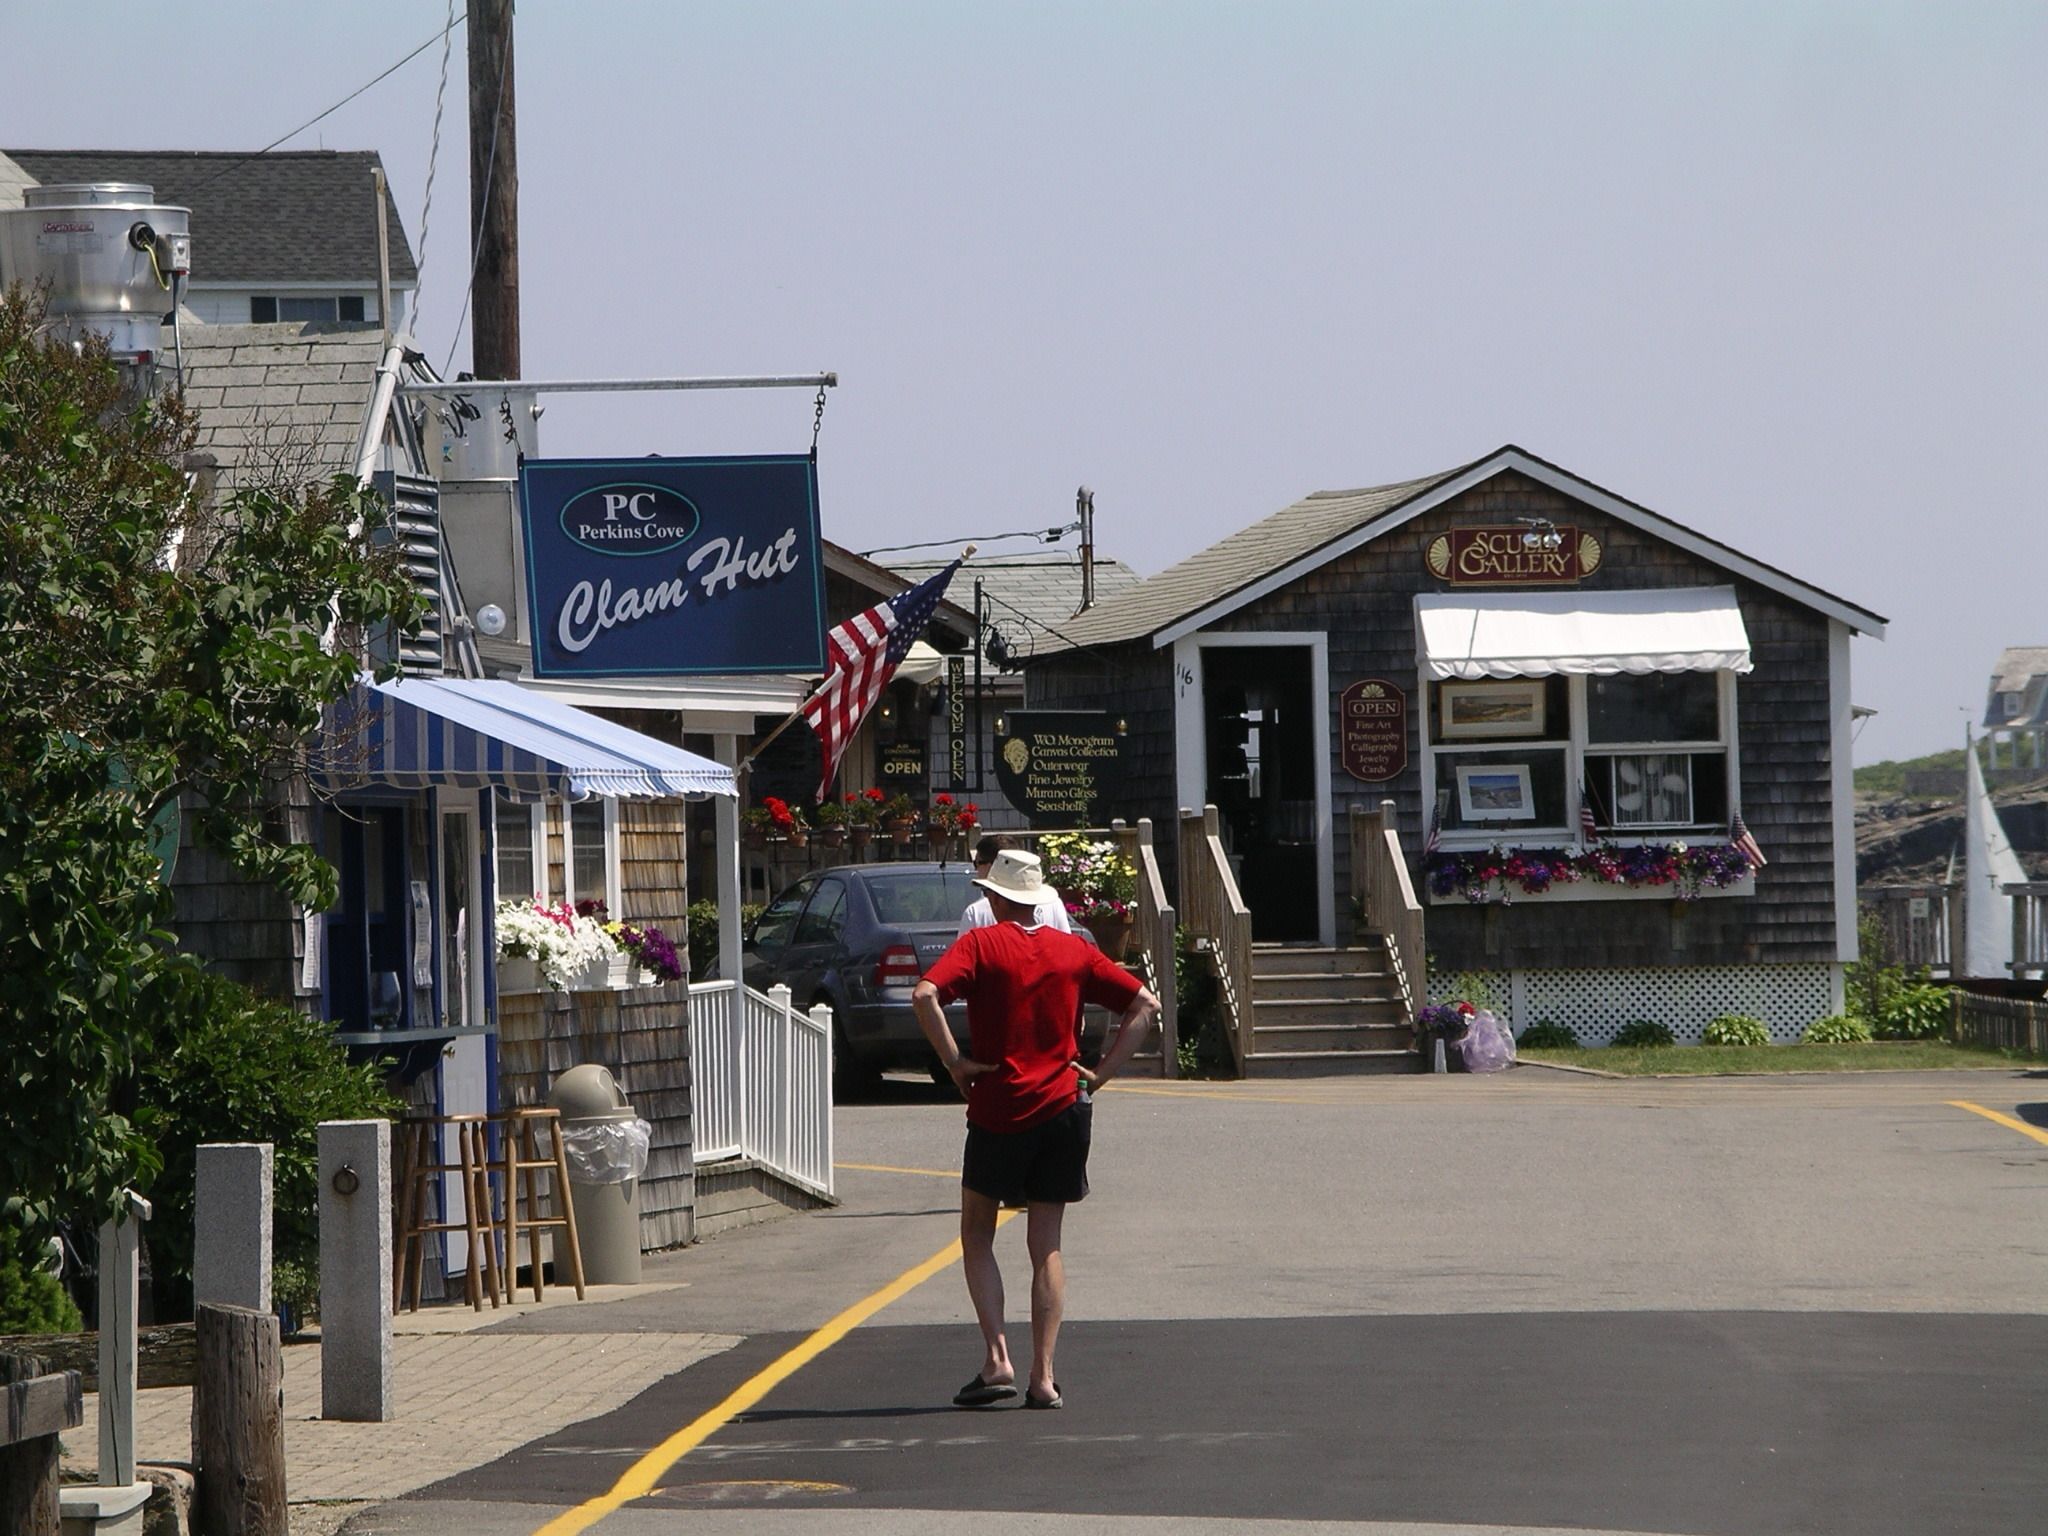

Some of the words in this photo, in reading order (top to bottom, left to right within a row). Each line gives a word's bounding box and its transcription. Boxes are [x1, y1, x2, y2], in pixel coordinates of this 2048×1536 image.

[602, 492, 657, 521] PC
[579, 524, 642, 539] Perkins
[643, 523, 684, 539] Cove
[1459, 546, 1572, 576] GALLERY
[558, 578, 688, 652] Clam
[687, 527, 799, 597] Hut
[951, 663, 964, 733] WELCOME
[1353, 703, 1396, 714] OPEN
[1058, 735, 1114, 748] Monogram
[1032, 746, 1068, 757] Canvas
[1069, 746, 1118, 757] Collection
[951, 739, 965, 781] OPEN
[1033, 759, 1090, 772] Outerwear
[884, 762, 921, 774] OPEN
[1028, 774, 1050, 785] Fine
[1025, 787, 1068, 798] Murano
